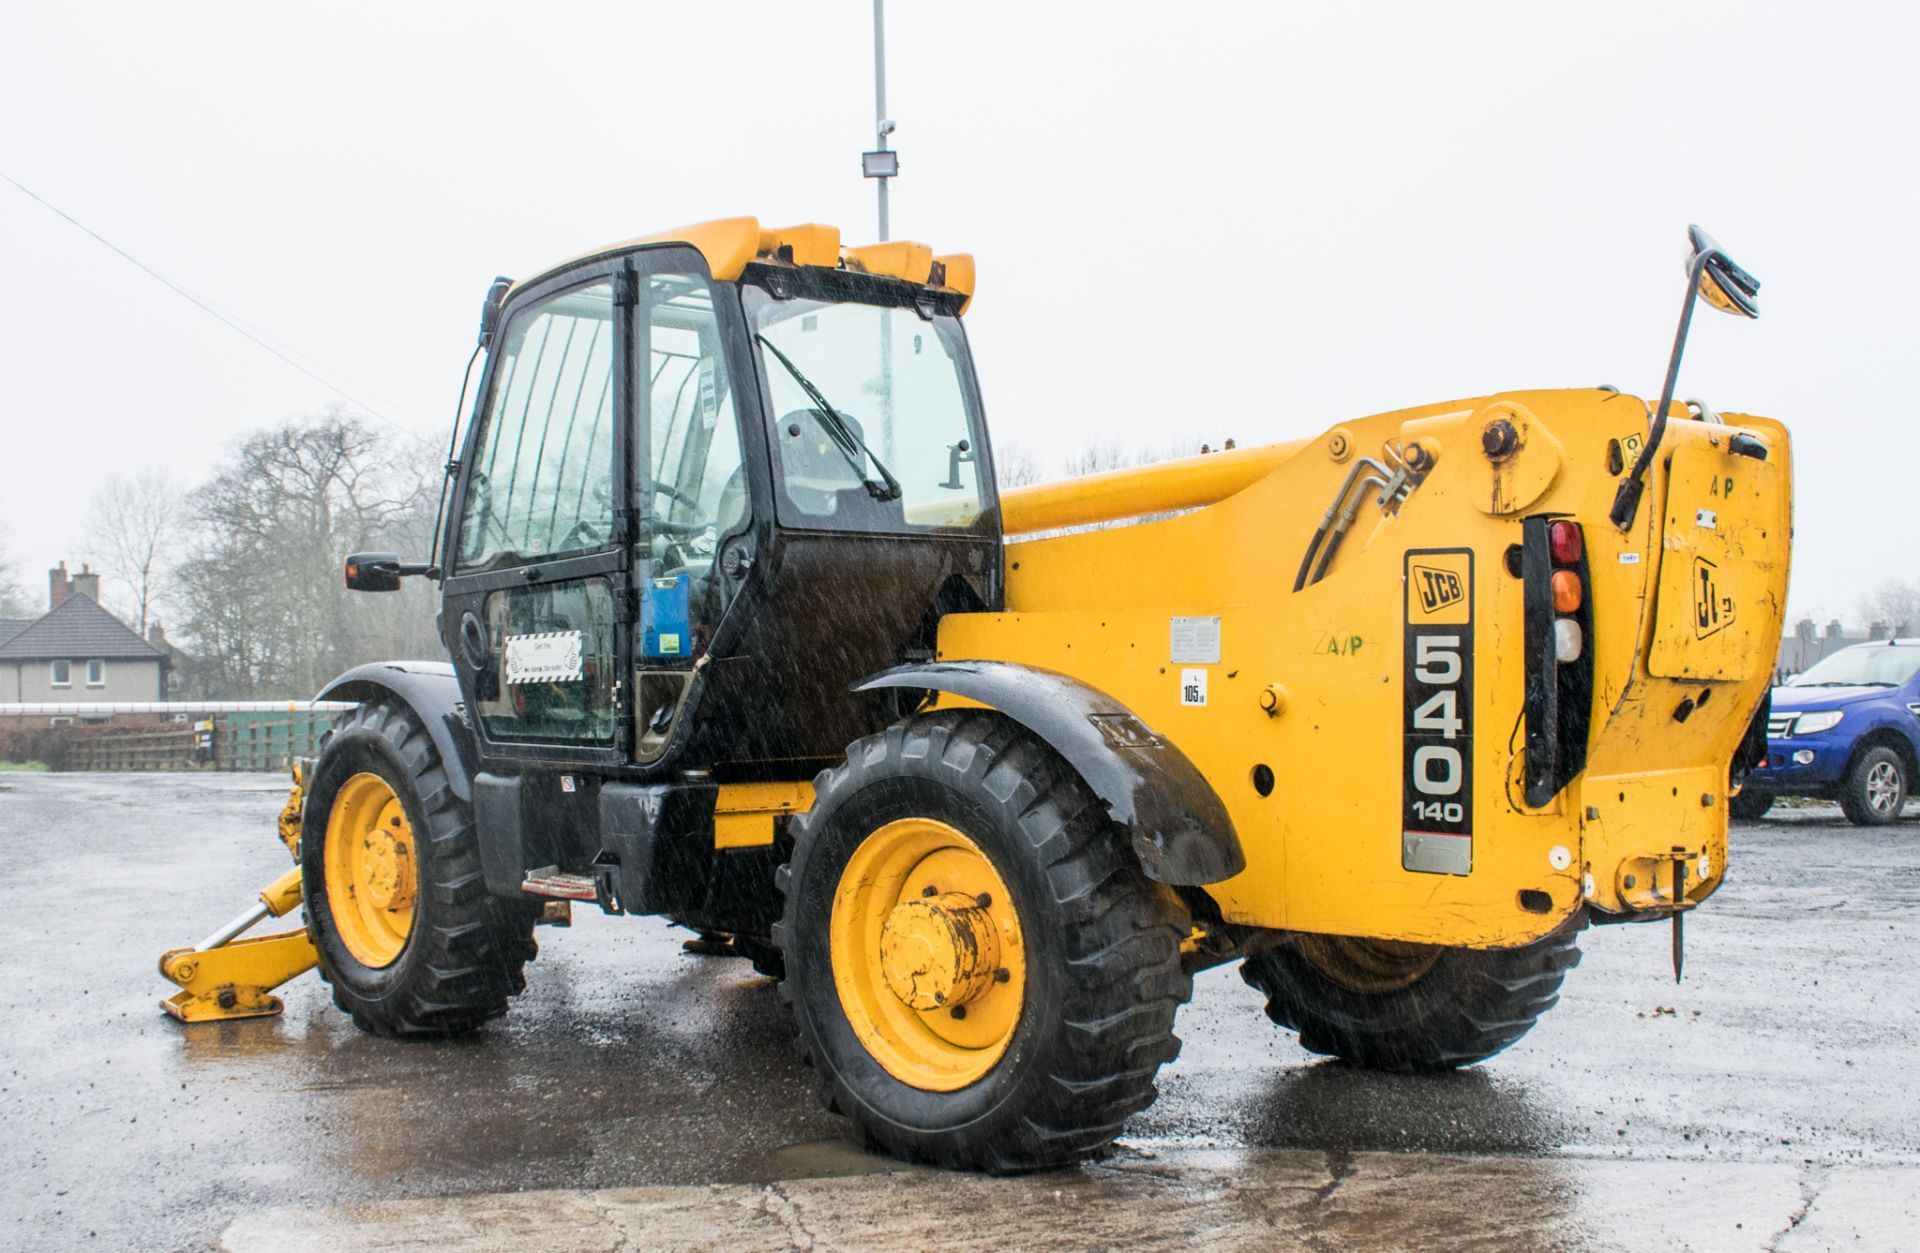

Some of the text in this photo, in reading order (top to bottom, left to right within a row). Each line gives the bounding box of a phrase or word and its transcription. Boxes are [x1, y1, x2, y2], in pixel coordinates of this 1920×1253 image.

[1422, 570, 1462, 609] JCB
[1184, 685, 1199, 703] 105
[1413, 635, 1463, 796] 540
[1412, 801, 1464, 823] 140
